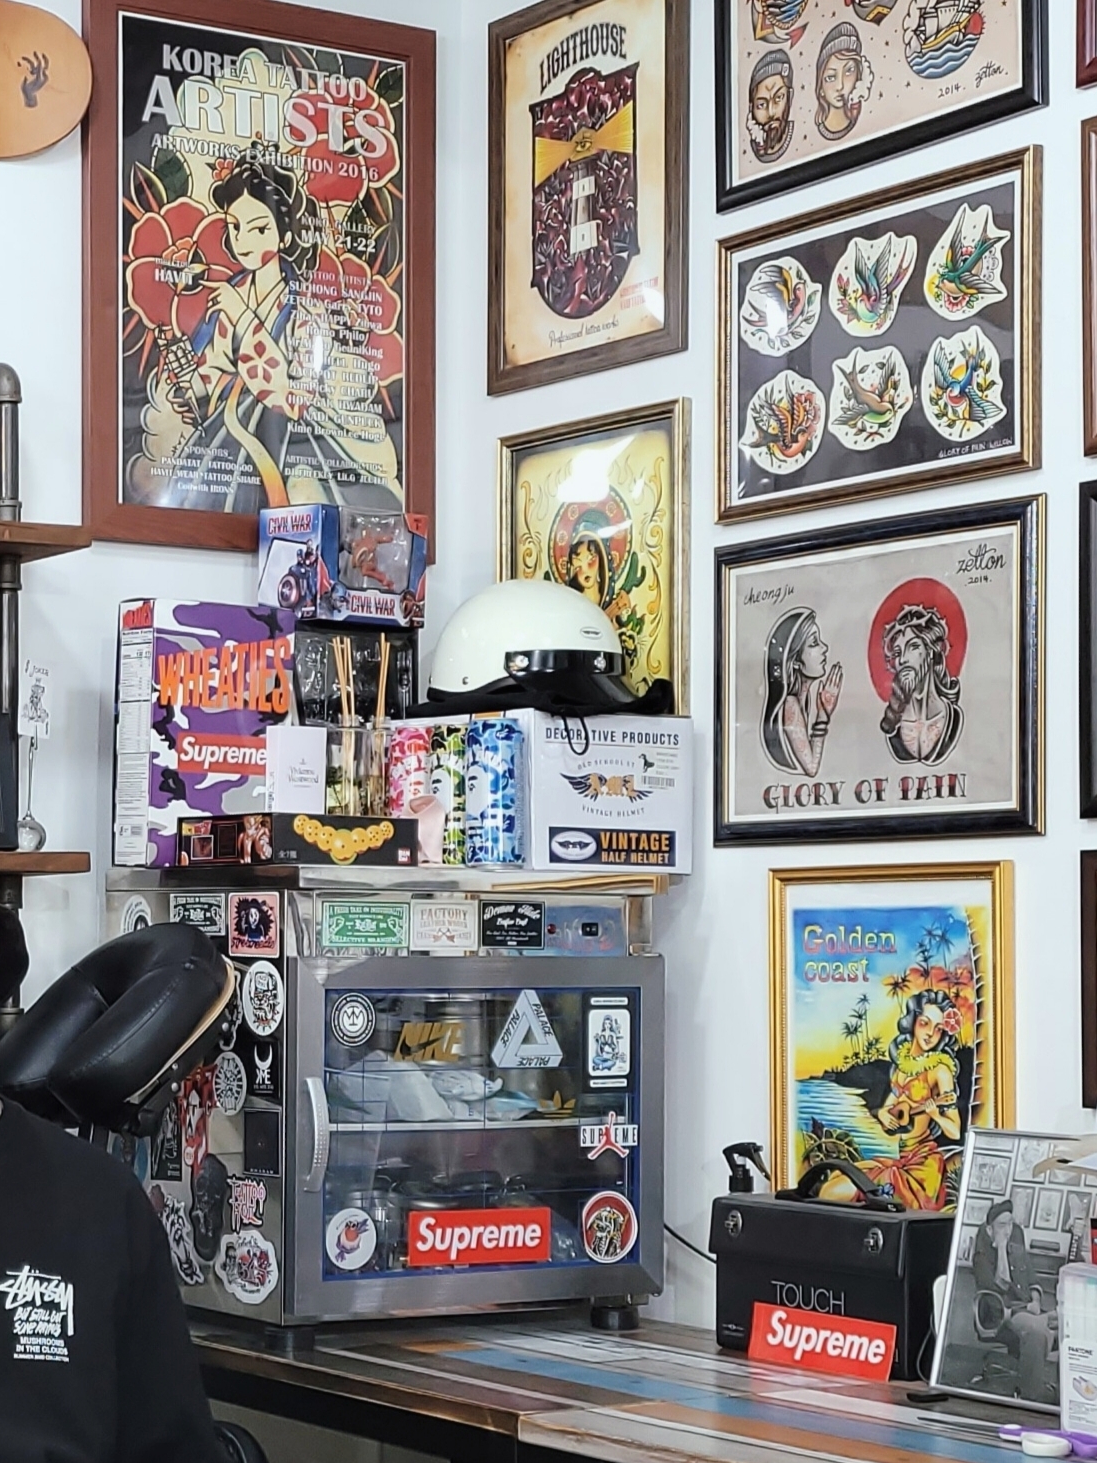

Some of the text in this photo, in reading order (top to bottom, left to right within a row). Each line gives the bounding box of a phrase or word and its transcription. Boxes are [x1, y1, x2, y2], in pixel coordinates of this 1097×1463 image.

[162, 43, 368, 101] KOREA TATTOO
[539, 23, 628, 94] LIGHTHOUSE
[141, 74, 388, 159] ARTISTS
[151, 133, 379, 182] ARTWORKS EXHIBITION 2016
[301, 230, 376, 253] MAY 21-22
[154, 268, 194, 285] HAVIT
[303, 269, 335, 281] TATTOO
[358, 303, 383, 317] TYTO
[268, 512, 313, 536] CIVIL WAR
[350, 594, 396, 616] CIVIL WAR
[159, 636, 294, 714] WHEATIES
[546, 727, 680, 746] DECORTIVE PRODUCTS
[180, 736, 266, 769] Supreme
[762, 773, 968, 814] GLORY OF PAIN
[600, 831, 671, 852] VINTAGE
[601, 851, 670, 864] HALF HELMET
[421, 908, 468, 921] FACTORY
[803, 924, 898, 954] Golden
[804, 957, 870, 984] coast
[500, 1009, 521, 1048] PALACE
[532, 1003, 553, 1037] PALACE
[394, 1022, 466, 1062] NIKE
[517, 1056, 551, 1067] PALACE
[582, 1126, 637, 1145] SUPEME
[416, 1215, 542, 1253] Supreme
[770, 1280, 845, 1315] TOUCH
[19, 1336, 65, 1347] MUSHROOMS
[25, 1345, 41, 1353] THE
[766, 1310, 886, 1364] Supreme
